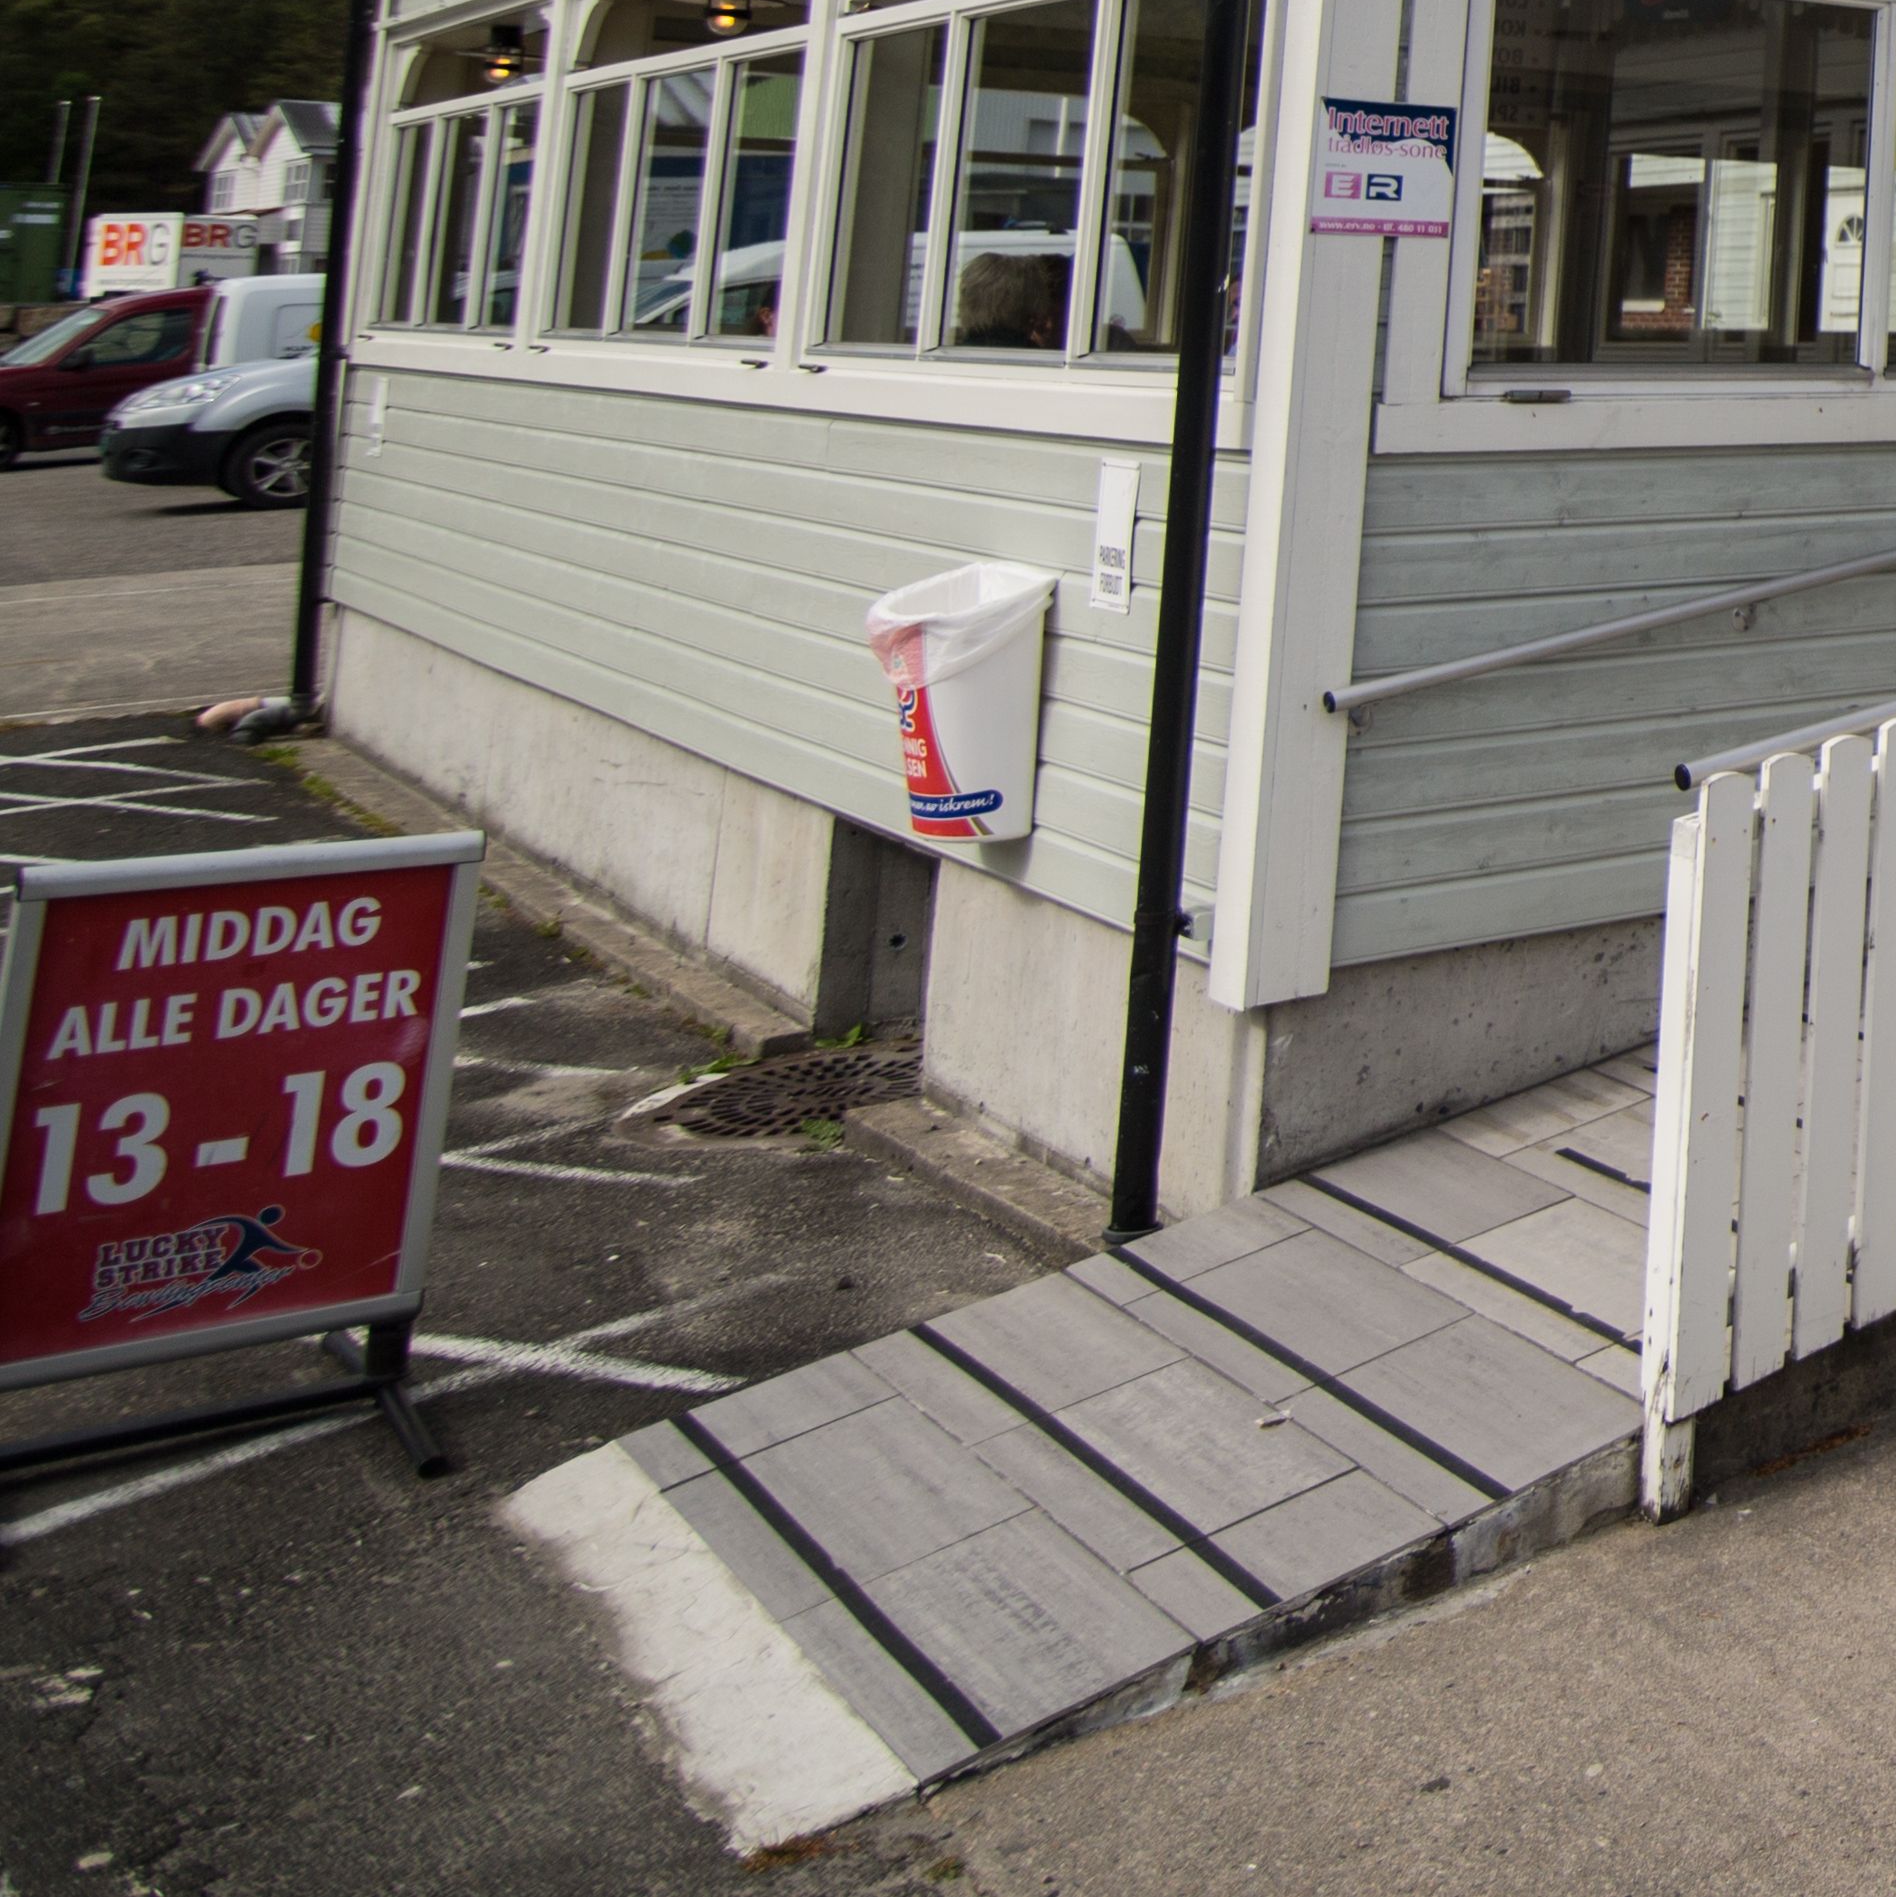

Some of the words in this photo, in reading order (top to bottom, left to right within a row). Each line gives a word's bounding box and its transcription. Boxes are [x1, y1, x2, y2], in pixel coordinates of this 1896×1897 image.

[1328, 106, 1449, 140] Internett
[1328, 134, 1448, 160] trådløs-sone
[100, 223, 170, 265] BRG
[183, 223, 258, 249] BRG
[116, 896, 383, 971] MIDDAG
[46, 992, 198, 1061] ALLE
[215, 969, 422, 1040] DAGER
[35, 1092, 171, 1217] 13
[283, 1061, 407, 1179] 18
[98, 1223, 230, 1269] LUCKY
[93, 1247, 223, 1289] STRIKE
